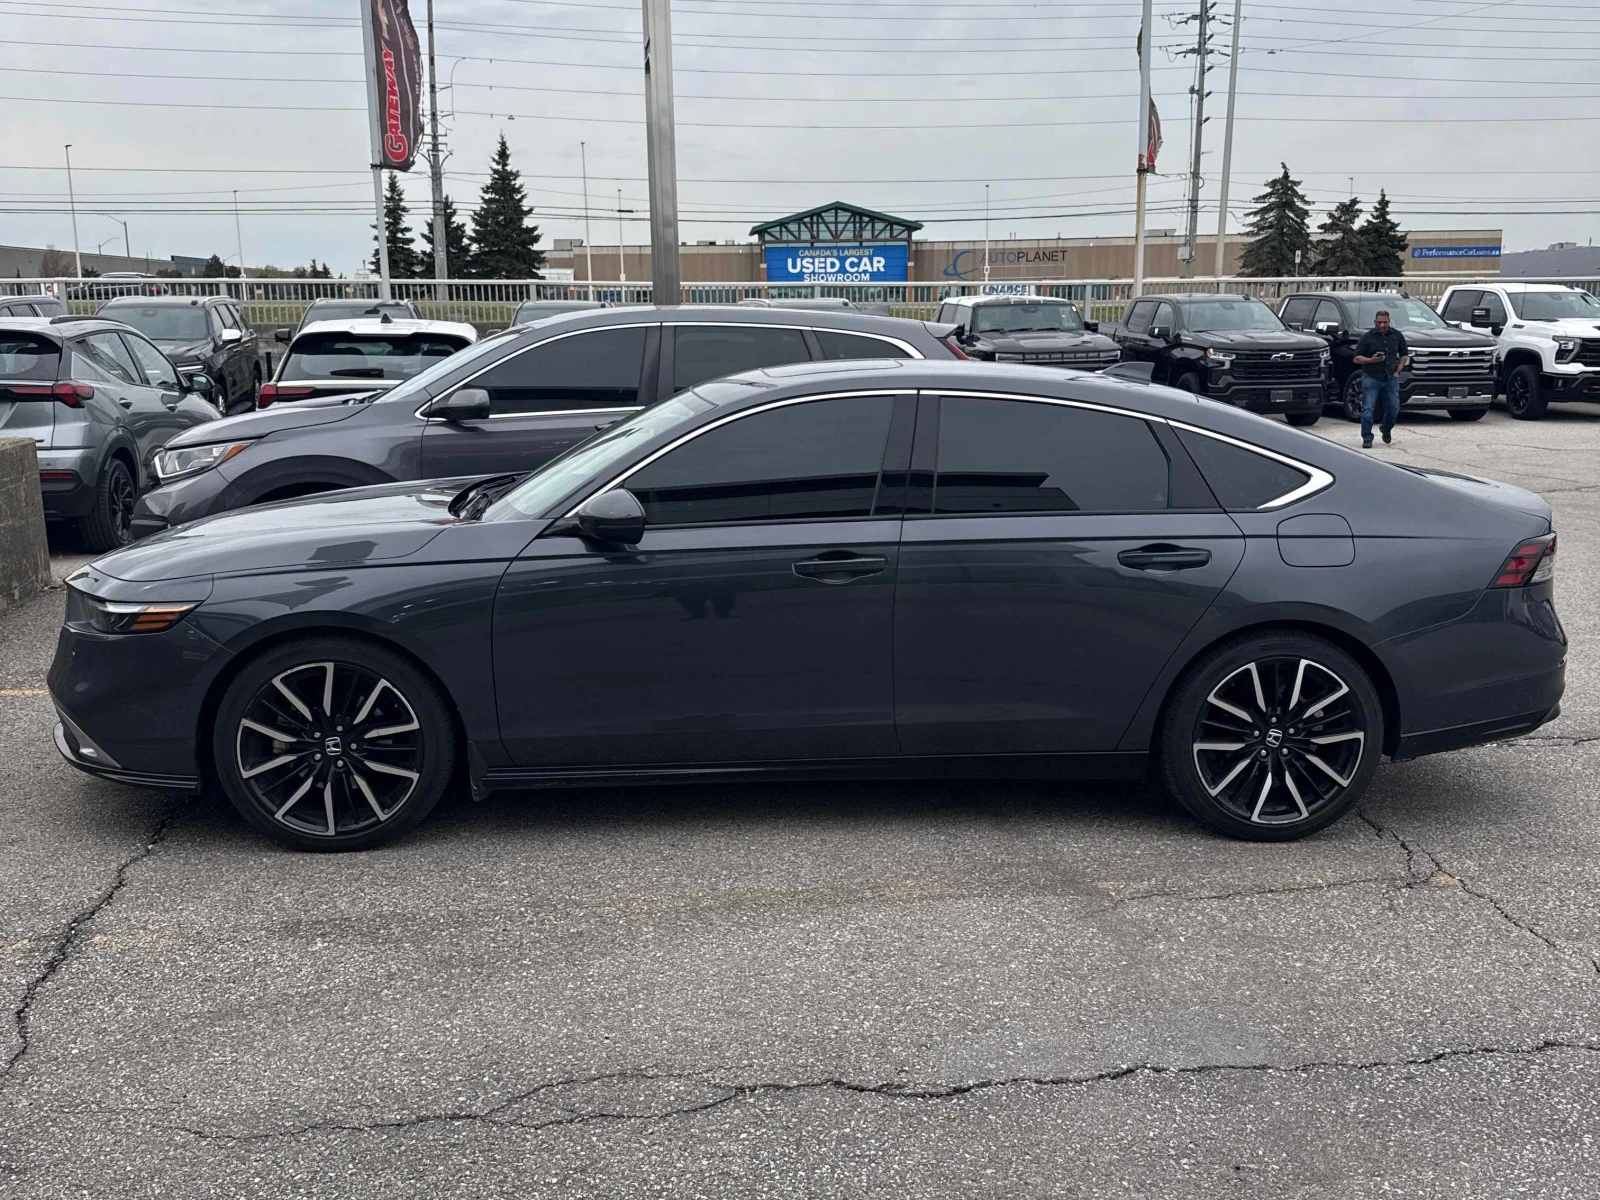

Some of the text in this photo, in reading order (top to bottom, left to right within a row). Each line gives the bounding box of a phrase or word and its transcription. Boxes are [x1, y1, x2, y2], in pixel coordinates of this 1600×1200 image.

[381, 39, 408, 162] GATEWAY
[798, 248, 874, 257] CANADA'S LARGEST
[980, 250, 1068, 264] AUTOPLANET
[787, 256, 886, 273] USED CAR
[803, 273, 870, 282] SHOWROOM
